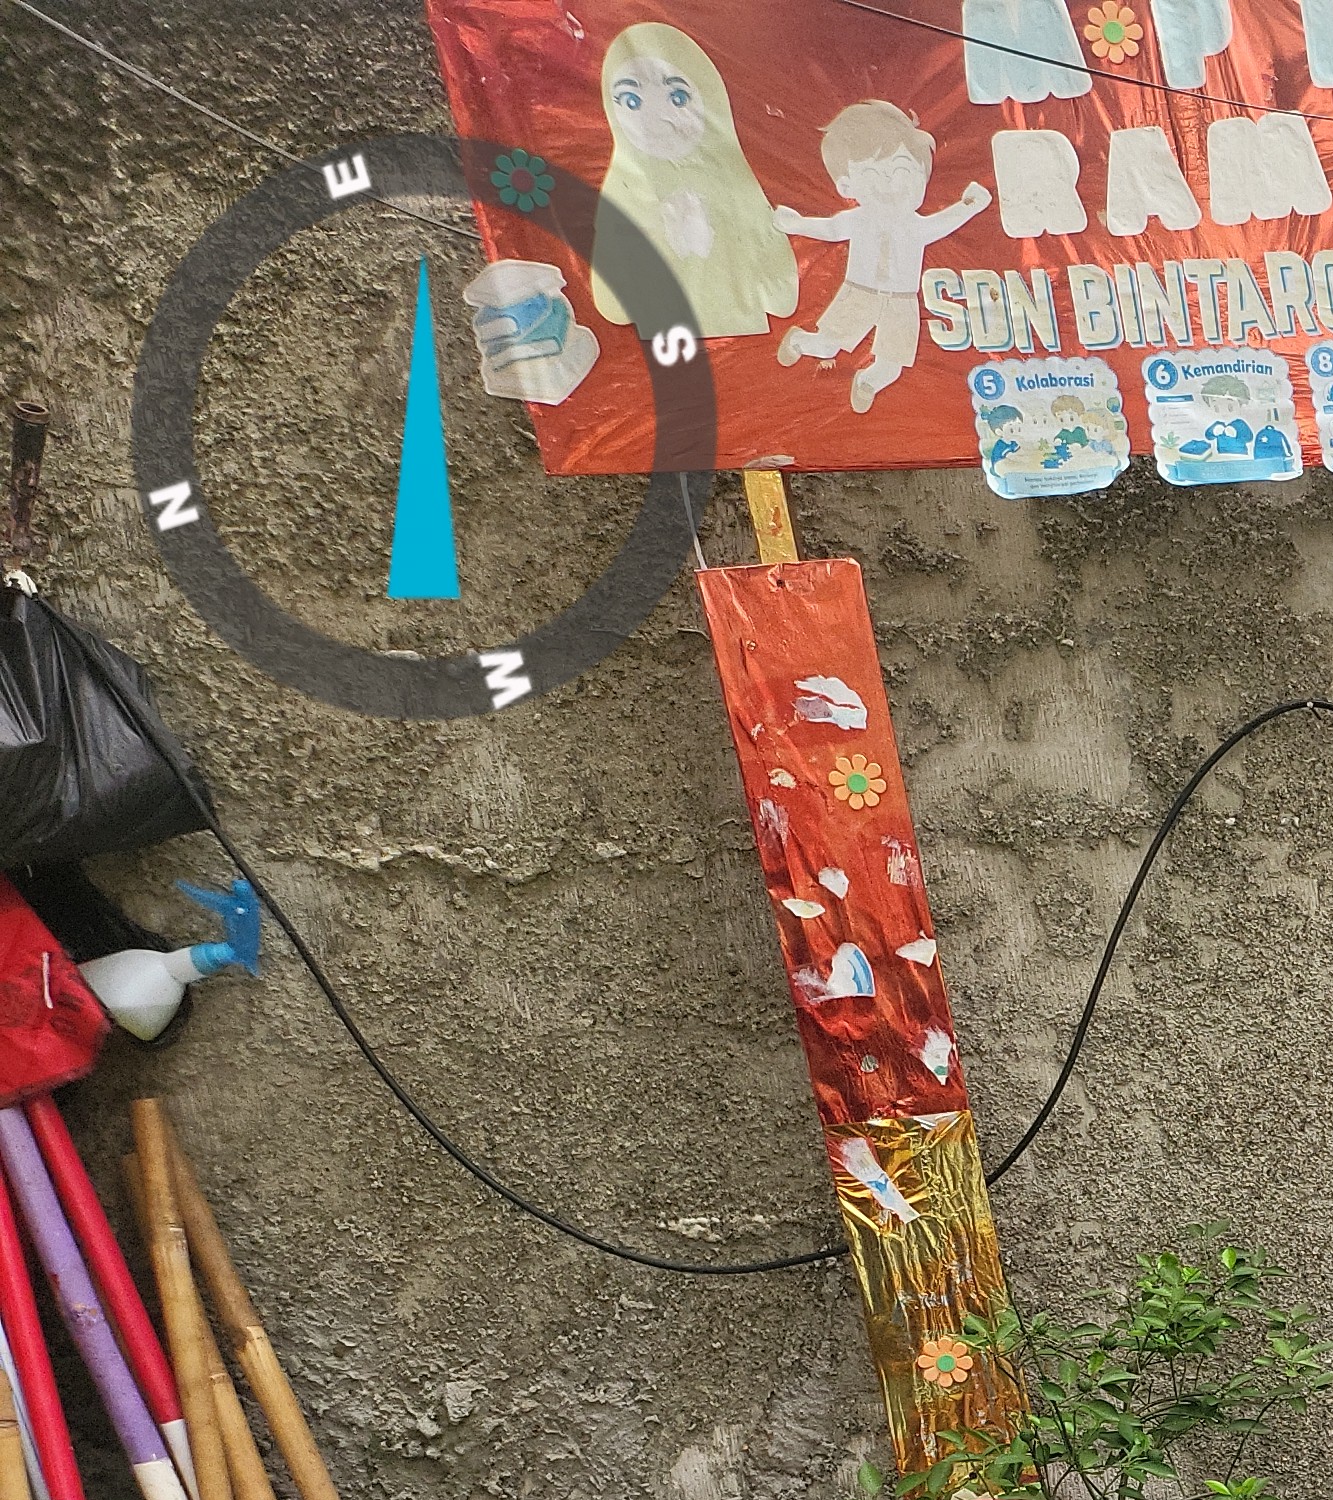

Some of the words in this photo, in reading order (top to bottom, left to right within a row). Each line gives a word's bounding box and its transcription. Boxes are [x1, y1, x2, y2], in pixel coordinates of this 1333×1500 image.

[922, 265, 1061, 353] SDN
[1181, 359, 1273, 381] Kemandirian
[1317, 351, 1333, 373] 8
[983, 375, 997, 396] 5
[1015, 372, 1095, 393] Kolaborasi
[1155, 364, 1171, 386] 6
